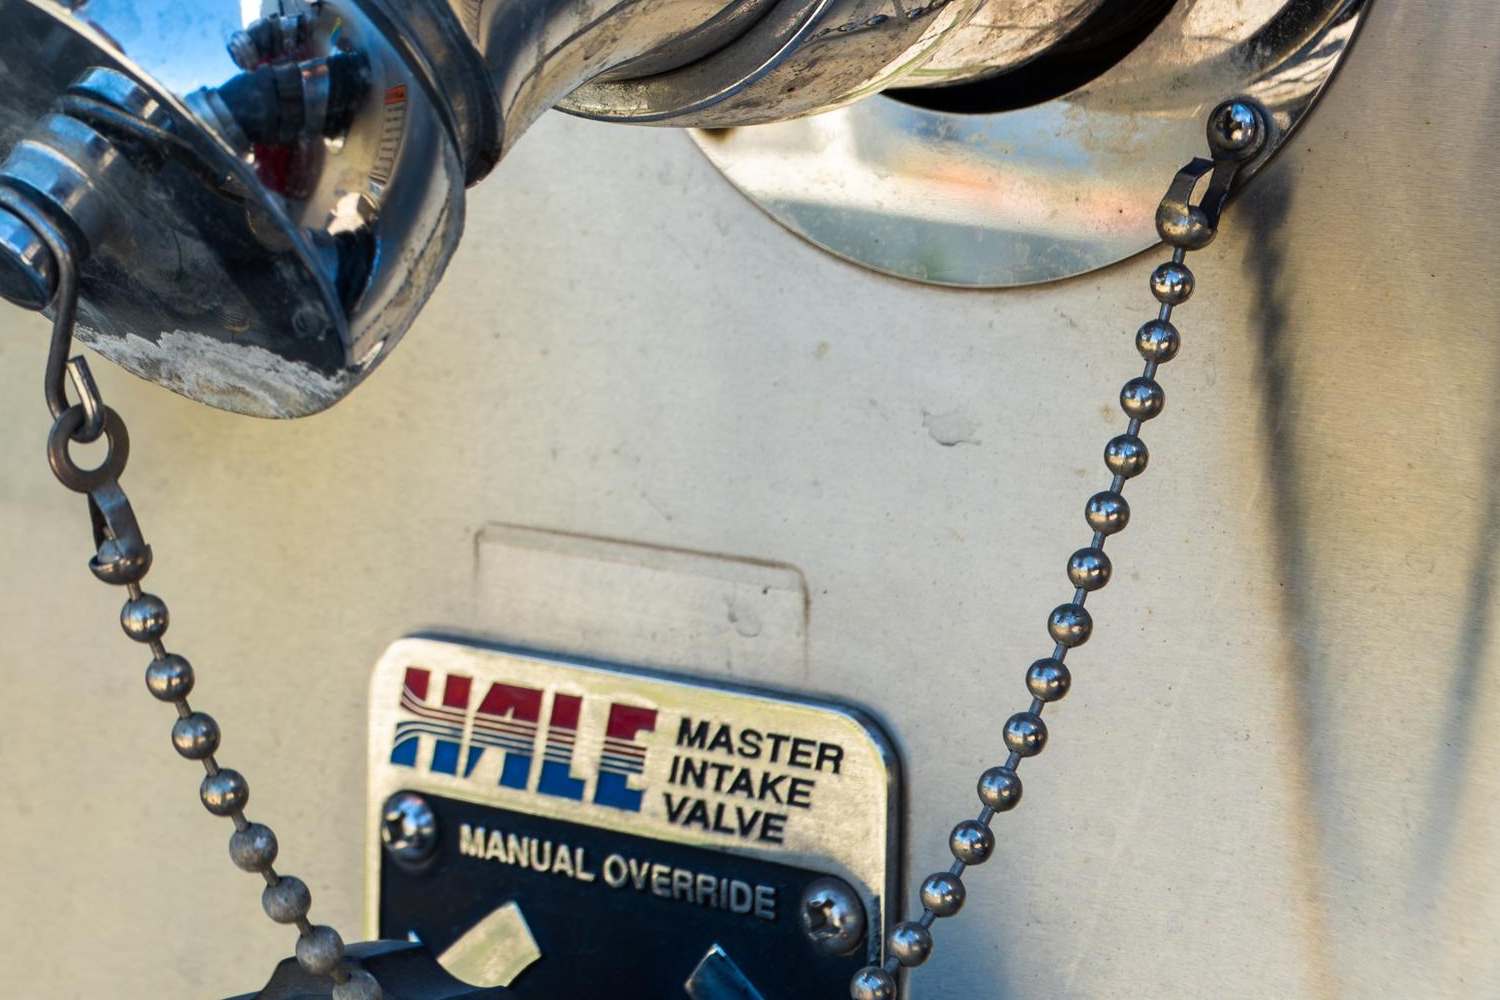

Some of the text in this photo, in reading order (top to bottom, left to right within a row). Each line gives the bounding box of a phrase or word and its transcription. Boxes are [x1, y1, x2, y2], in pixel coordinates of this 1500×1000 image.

[390, 666, 658, 812] HALE
[677, 717, 845, 775] MASTER
[668, 756, 814, 809] INTAKE
[663, 792, 788, 844] VALVE
[460, 823, 777, 920] MANUAL OVERRIDE
